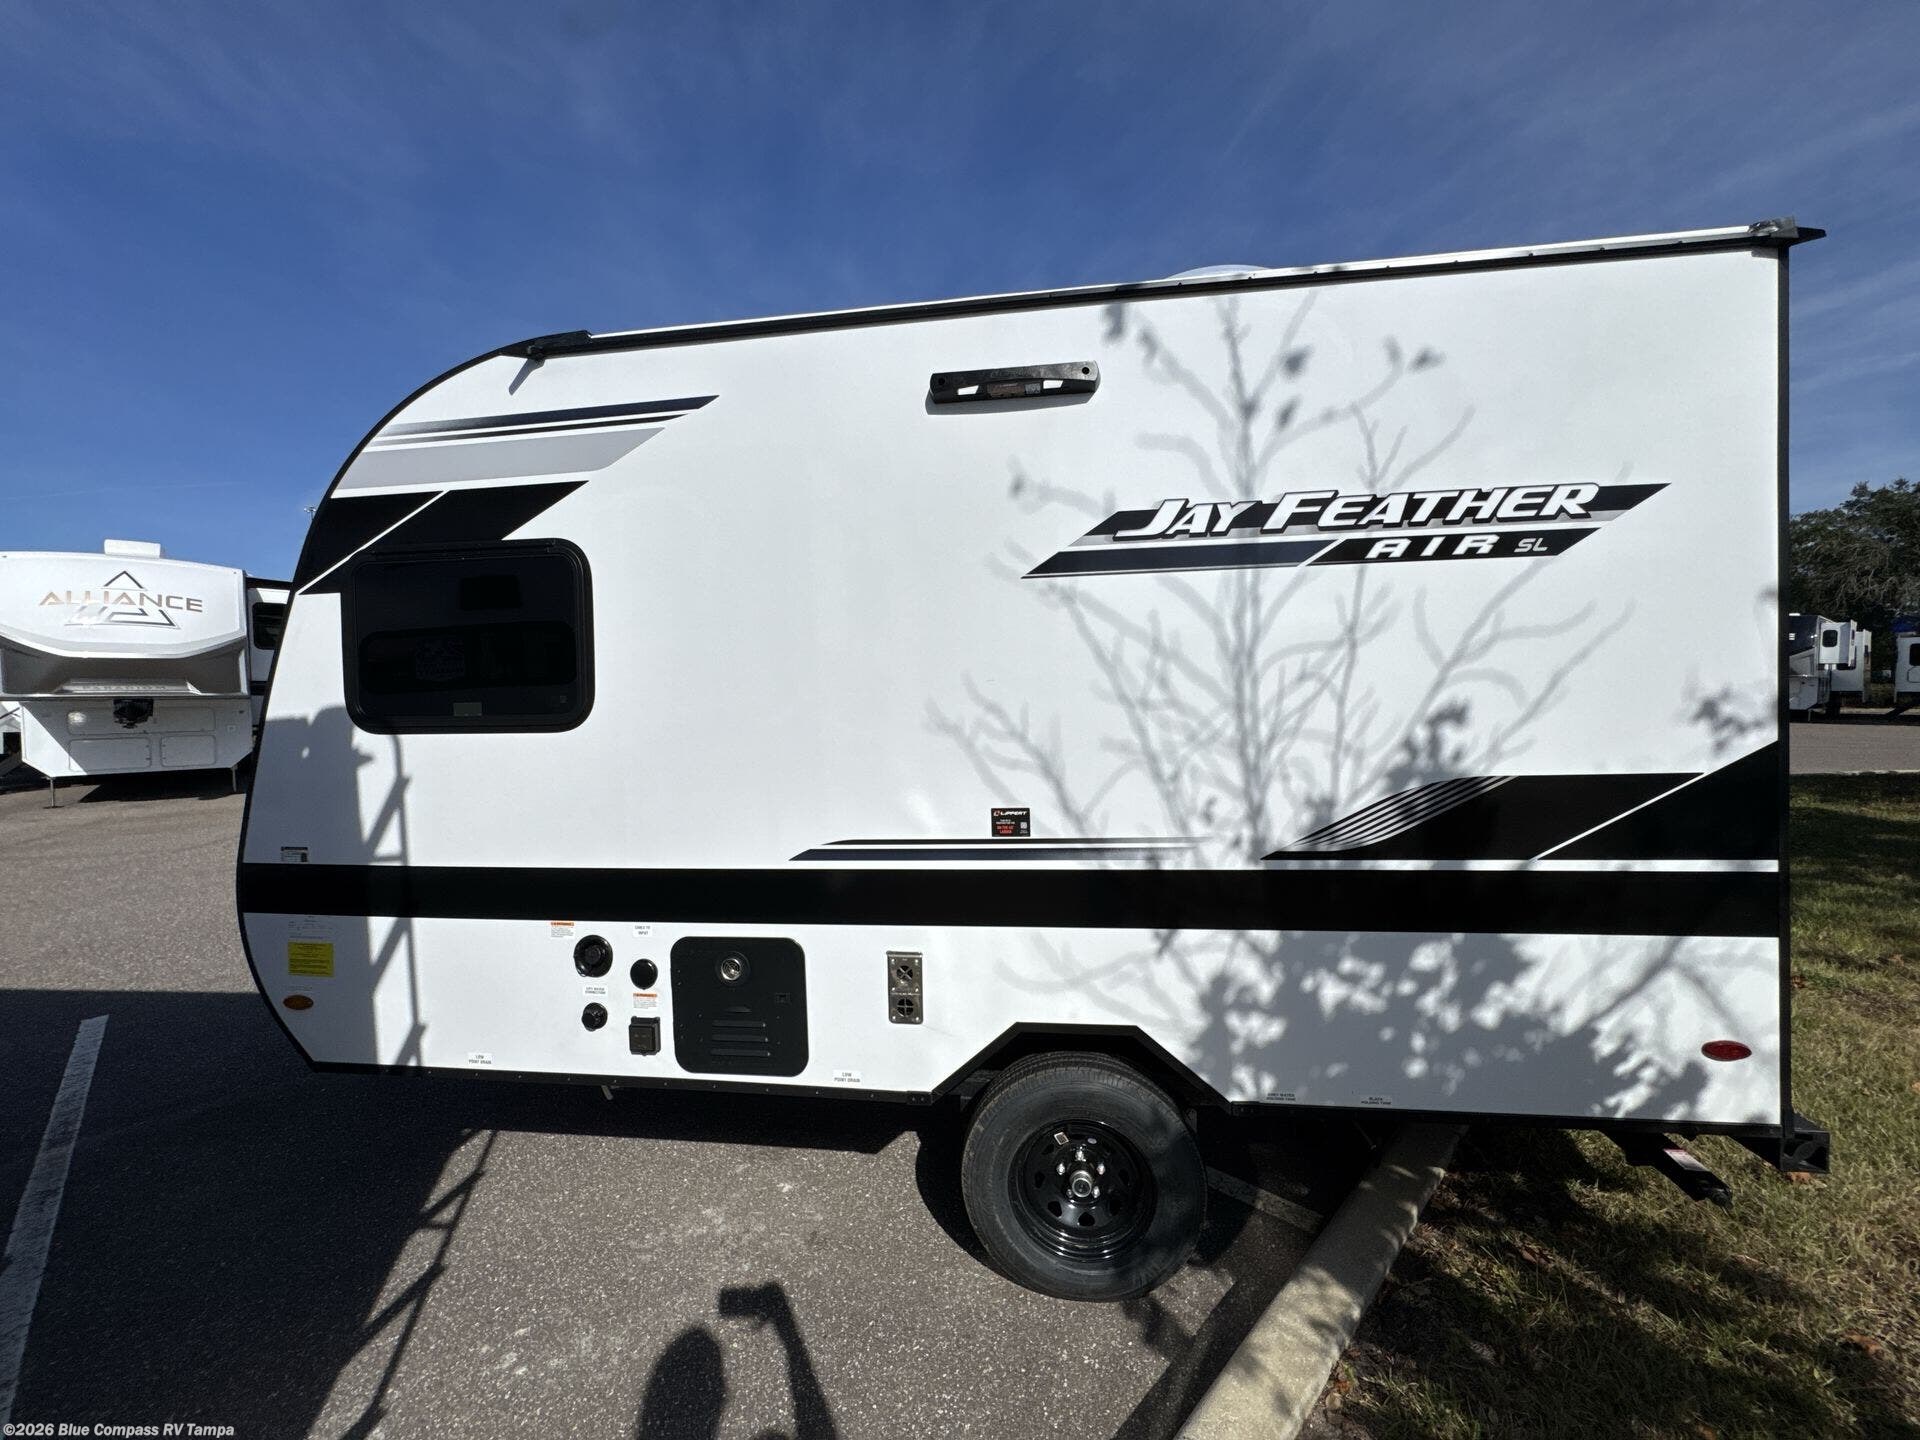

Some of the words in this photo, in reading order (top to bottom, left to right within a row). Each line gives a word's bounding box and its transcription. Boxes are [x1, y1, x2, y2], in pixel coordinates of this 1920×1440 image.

[1112, 498, 1262, 542] JAY
[1260, 482, 1600, 535] FEATHER
[1365, 534, 1500, 559] AIR
[1514, 538, 1548, 553] SL
[39, 590, 203, 613] ALLIANCE
